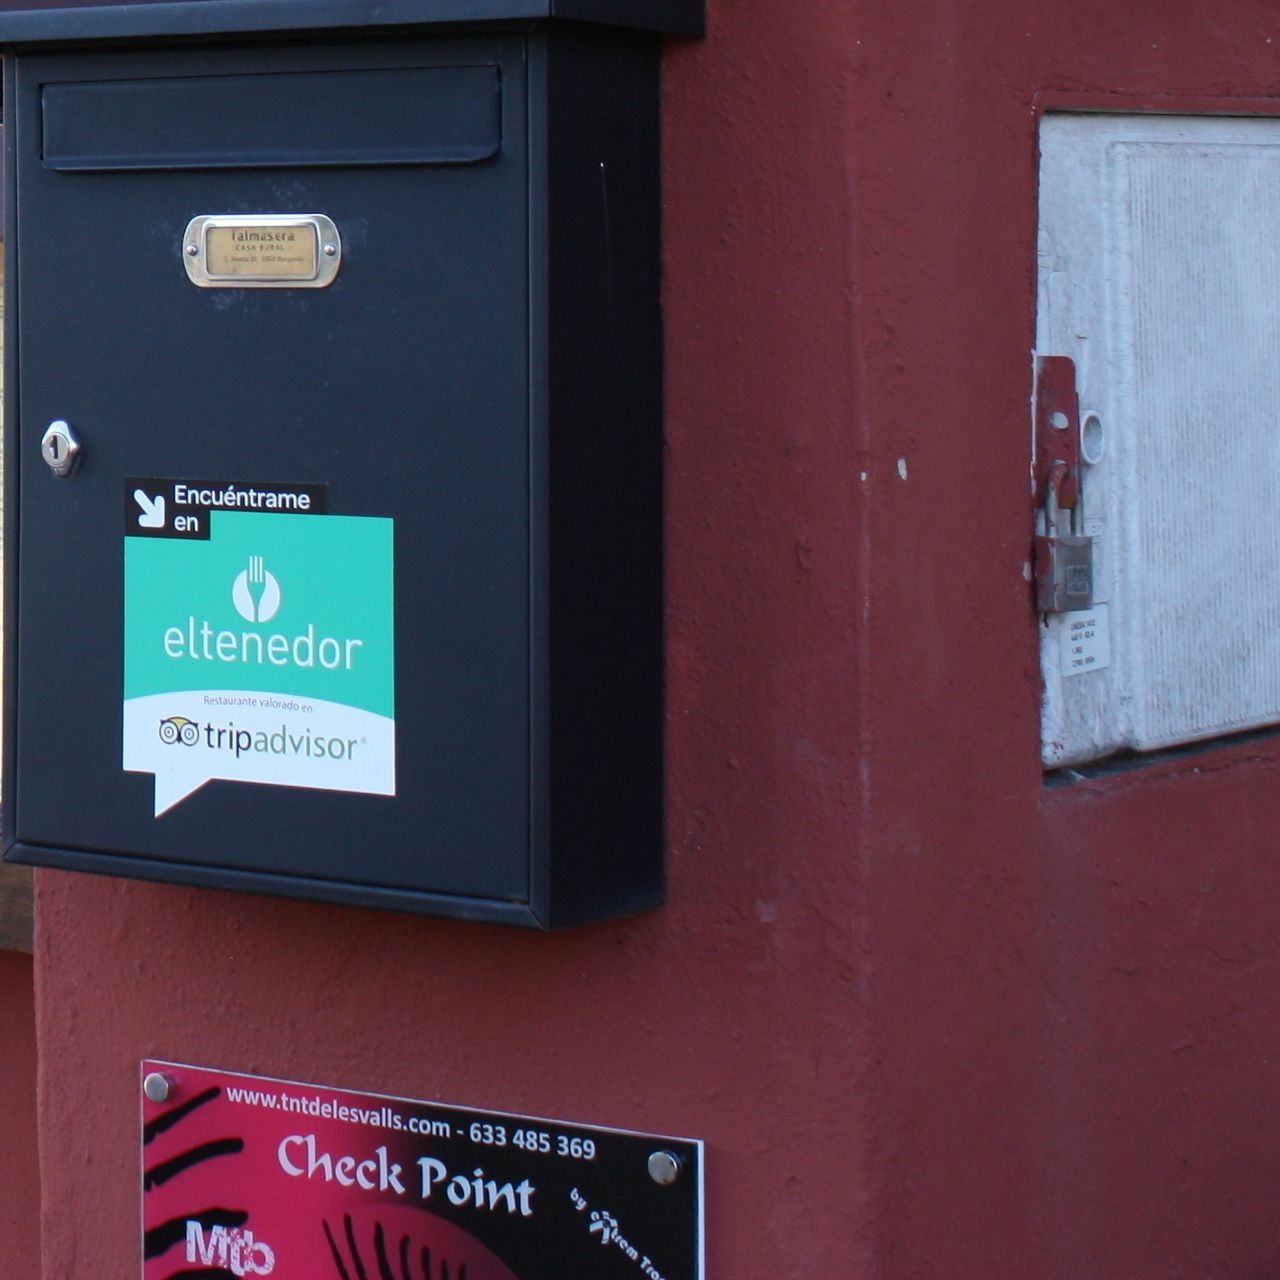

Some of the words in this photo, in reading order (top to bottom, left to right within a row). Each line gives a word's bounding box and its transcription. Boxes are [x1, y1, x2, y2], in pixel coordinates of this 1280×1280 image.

[174, 485, 311, 510] Encuéntrame
[174, 516, 199, 532] en
[163, 617, 363, 669] eltenedor
[203, 695, 257, 707] Restaurante
[259, 698, 300, 711] valorado
[301, 704, 313, 714] en
[204, 722, 358, 760] tripadvisor
[226, 1087, 451, 1138] www.tntdelesvalls.com
[469, 1122, 507, 1147] 633
[512, 1128, 551, 1153] 485
[557, 1135, 596, 1160] 369
[277, 1133, 406, 1195] Check
[416, 1156, 536, 1217] Point
[570, 1187, 587, 1211] by
